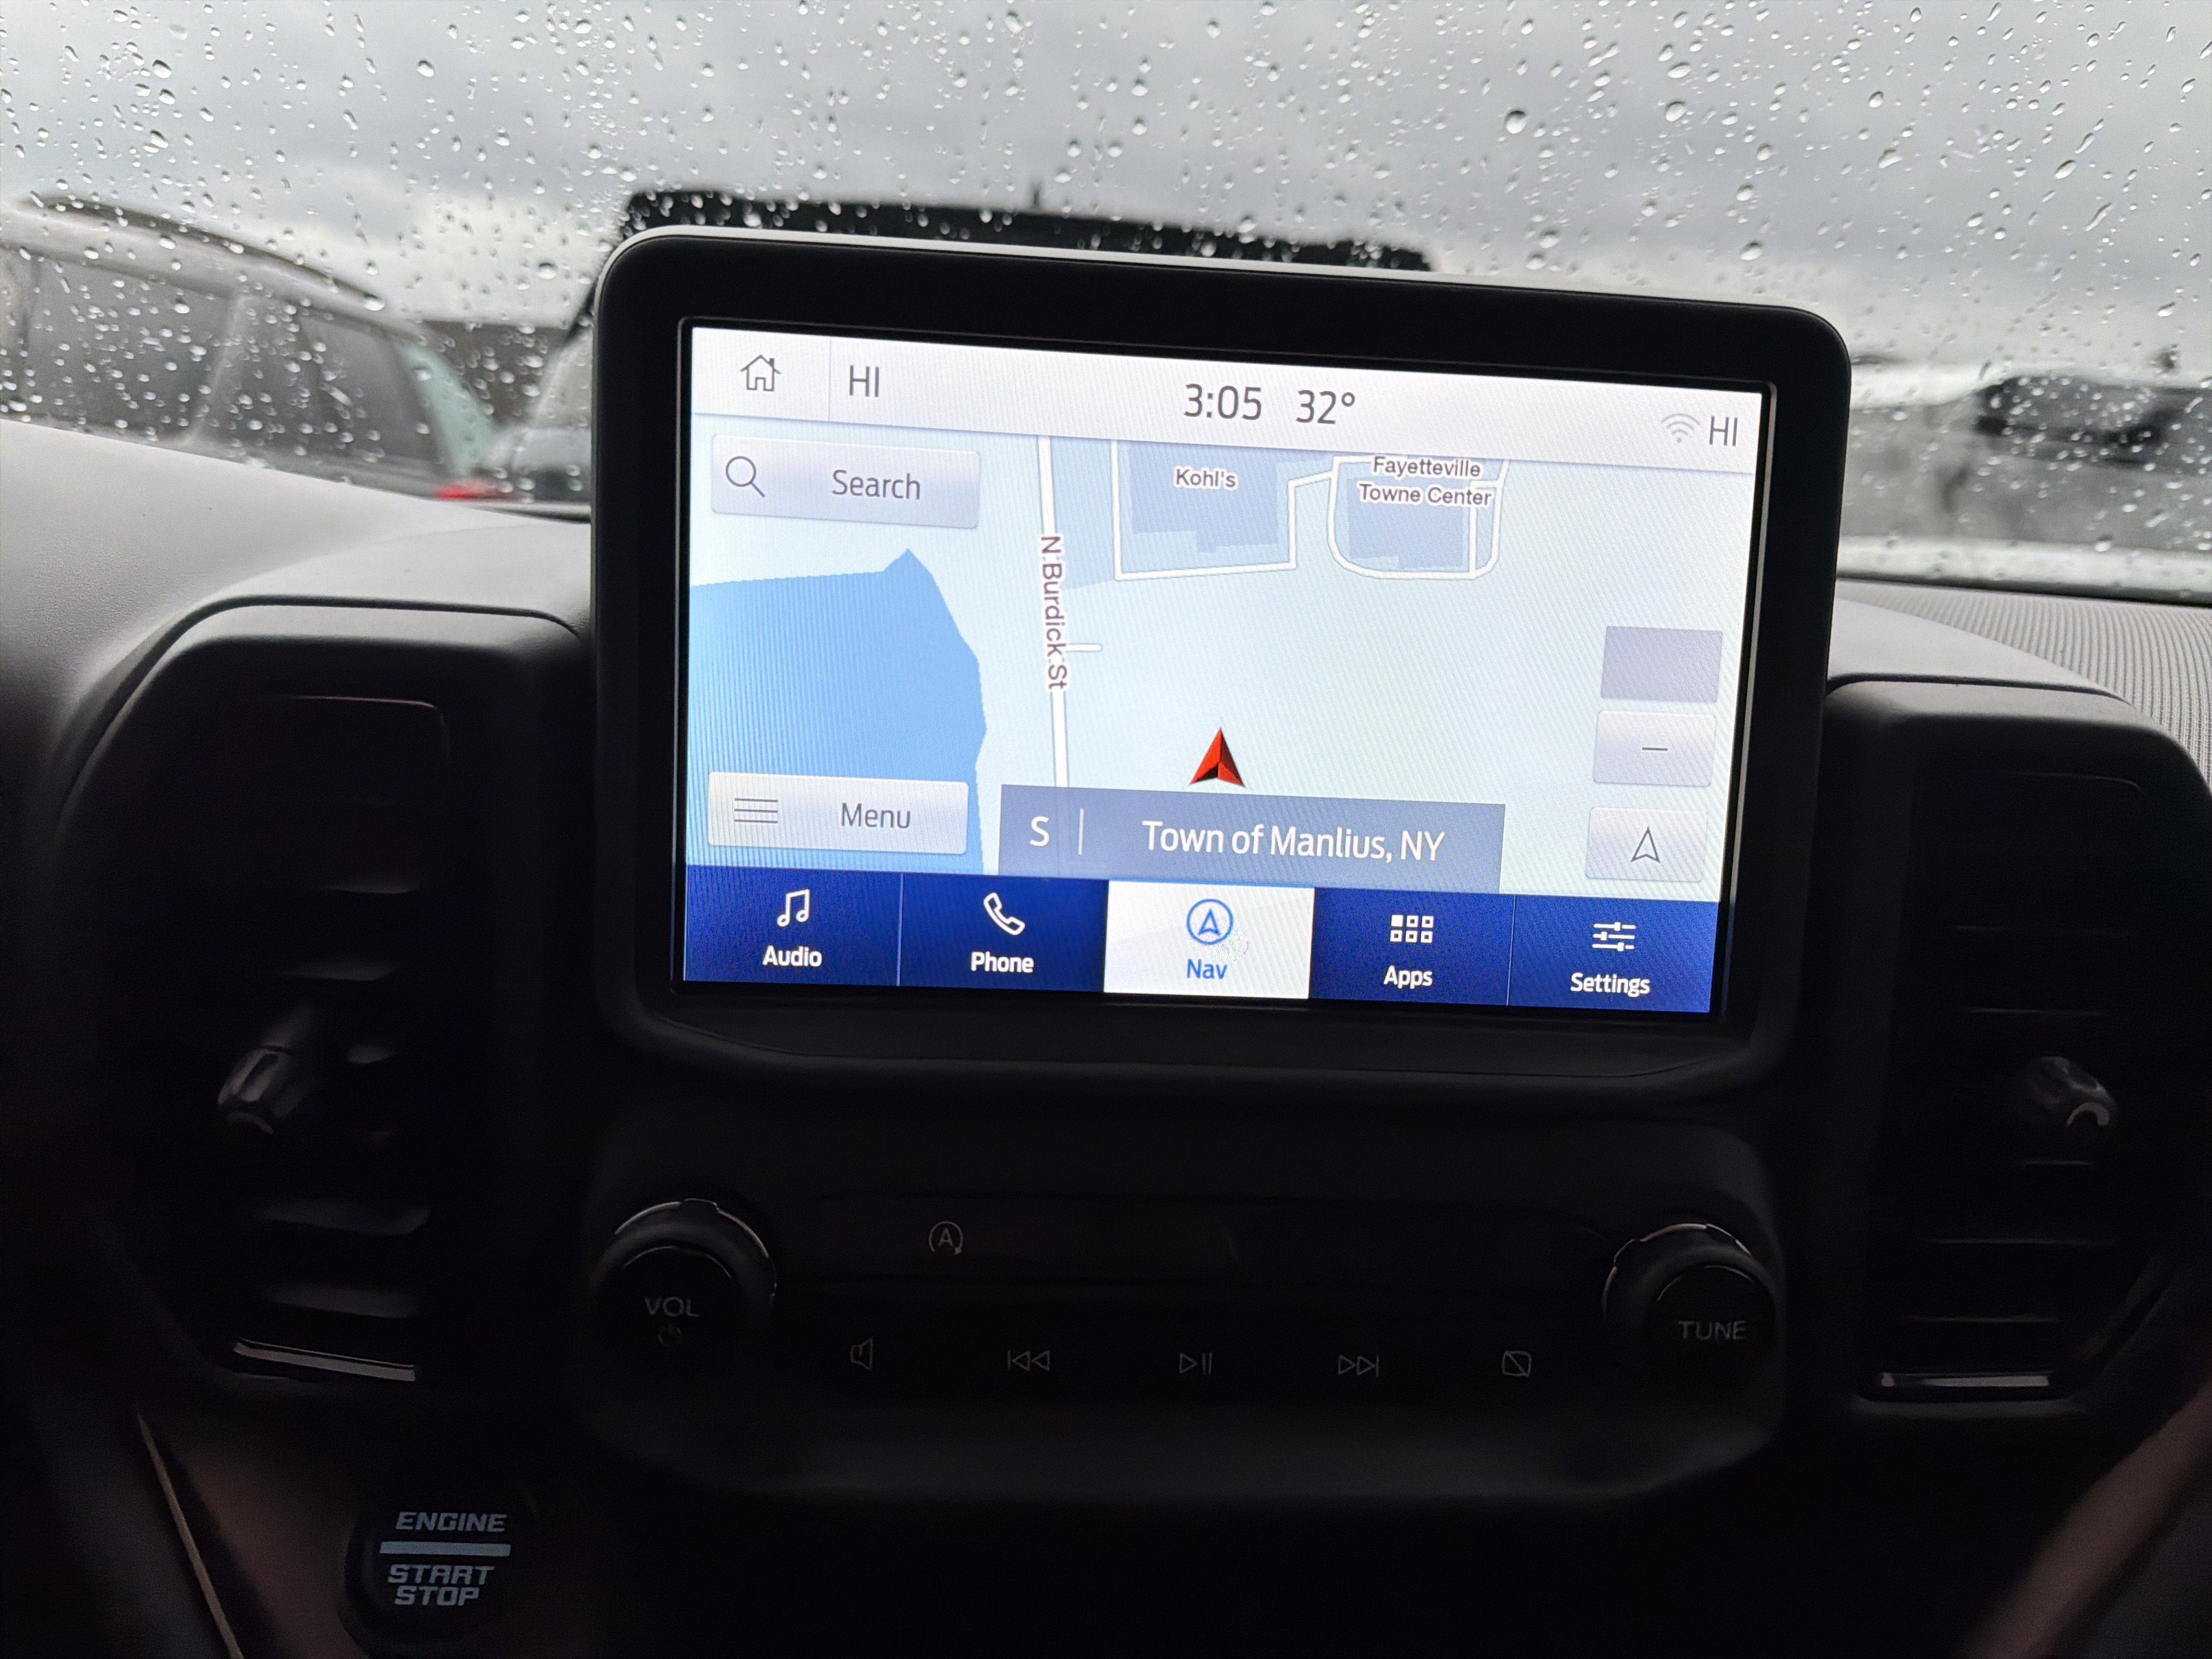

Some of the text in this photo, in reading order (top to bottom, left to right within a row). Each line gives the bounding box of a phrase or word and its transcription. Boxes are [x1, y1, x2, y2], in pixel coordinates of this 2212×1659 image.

[848, 364, 879, 398] HI
[1183, 383, 1356, 425] 3:05 32°
[1708, 416, 1738, 447] HI
[1373, 456, 1481, 477] Fayetteville
[832, 469, 921, 500] Search
[1175, 469, 1237, 489] Kohl's
[1359, 483, 1492, 506] Towne Center
[1041, 536, 1068, 690] N Burdick St
[840, 802, 911, 829] Menu
[1030, 816, 1050, 847] S
[1142, 820, 1446, 863] Town of Manlius, NY
[763, 945, 822, 967] Audio
[970, 951, 1035, 973] Phone
[1187, 958, 1228, 980] Nav
[1383, 965, 1434, 989] Apps
[1570, 972, 1650, 997] Settings
[645, 1297, 700, 1317] VOL
[1678, 1320, 1747, 1341] TUNE
[396, 1511, 508, 1532] ENGINE
[387, 1564, 495, 1585] START
[393, 1585, 481, 1606] STOP
